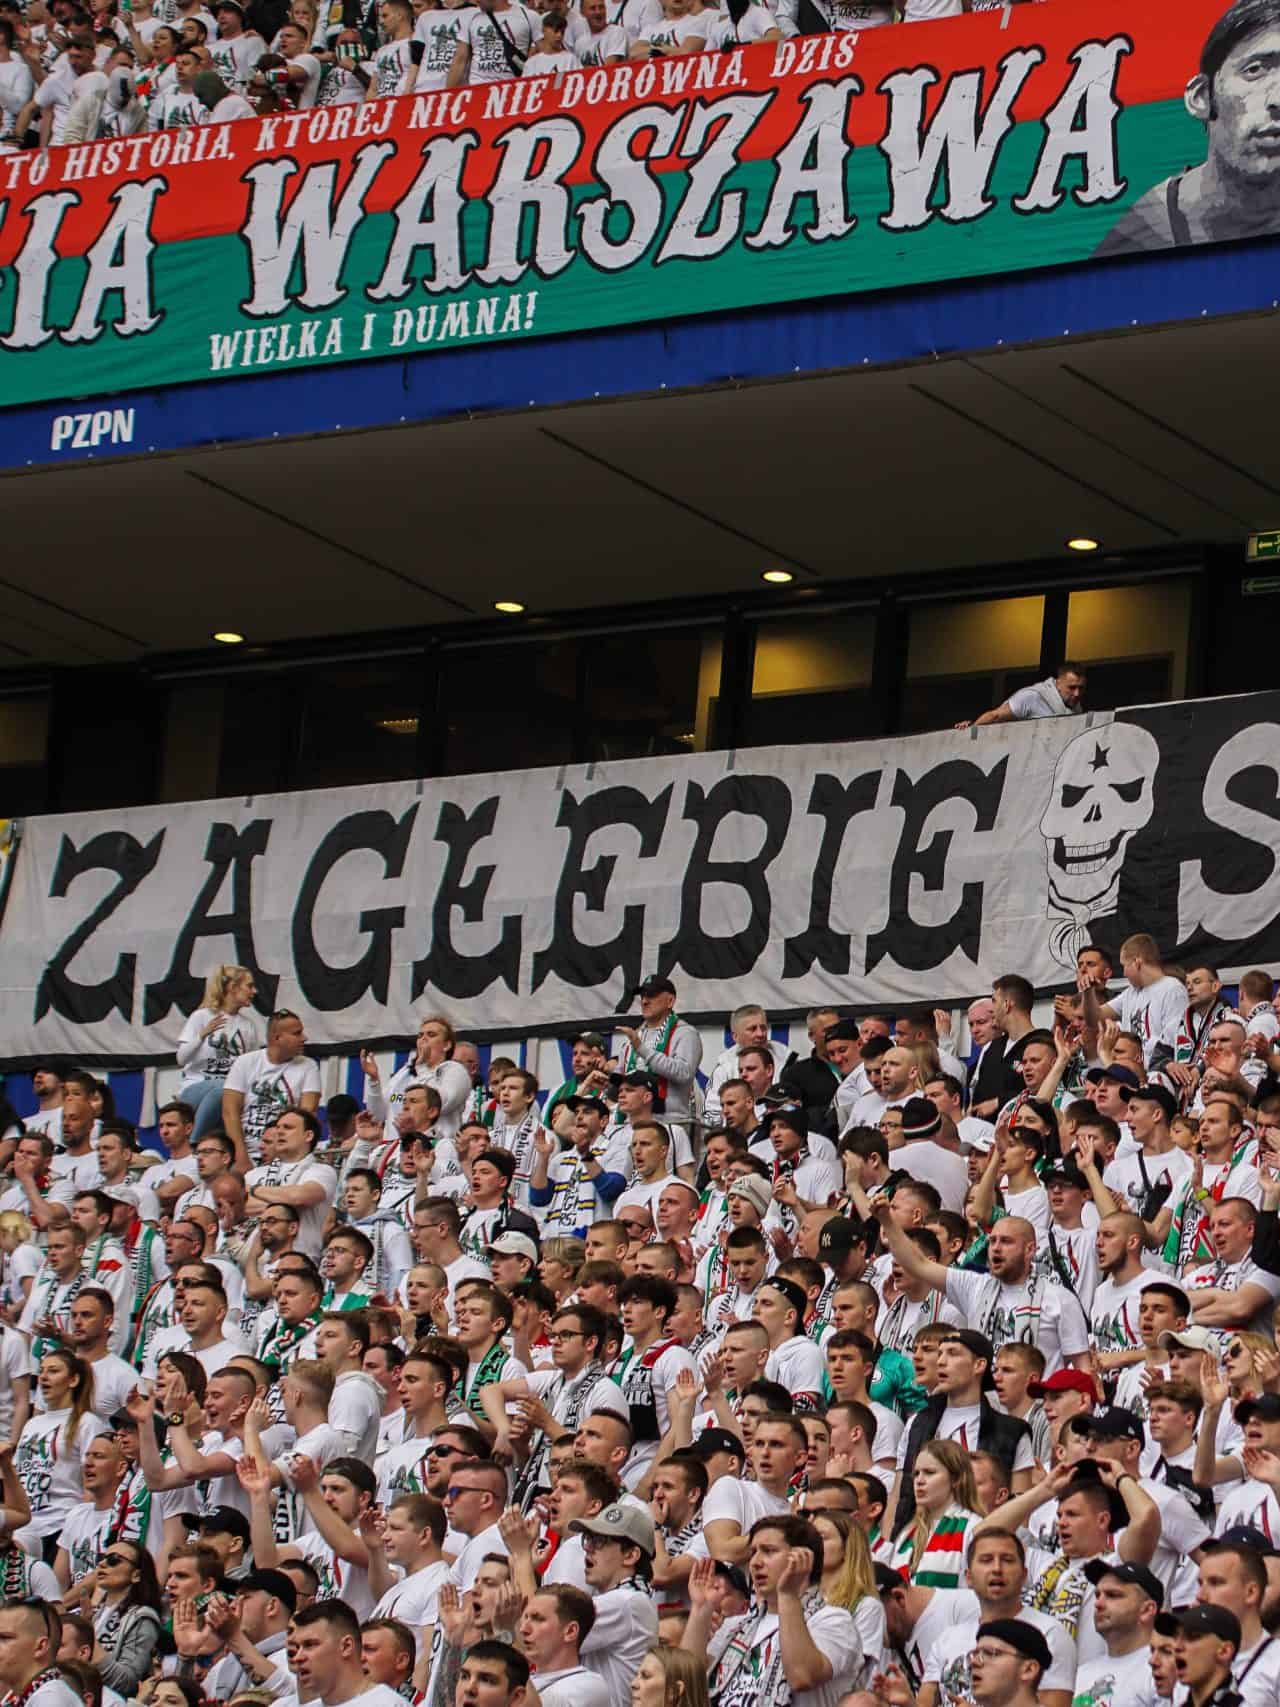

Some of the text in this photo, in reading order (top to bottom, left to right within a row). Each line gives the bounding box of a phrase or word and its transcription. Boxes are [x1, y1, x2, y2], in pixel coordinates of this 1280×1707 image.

[4, 30, 861, 189] TO HISTORIA, KTÓREJ NIC NIE DORÓWNA, DZIŚ
[0, 33, 1134, 352] IA WARSZAWA
[209, 290, 540, 371] WIELKA I DUMNA!
[50, 408, 136, 451] PZPN
[34, 752, 1011, 1025] ZAGŁĘBIE
